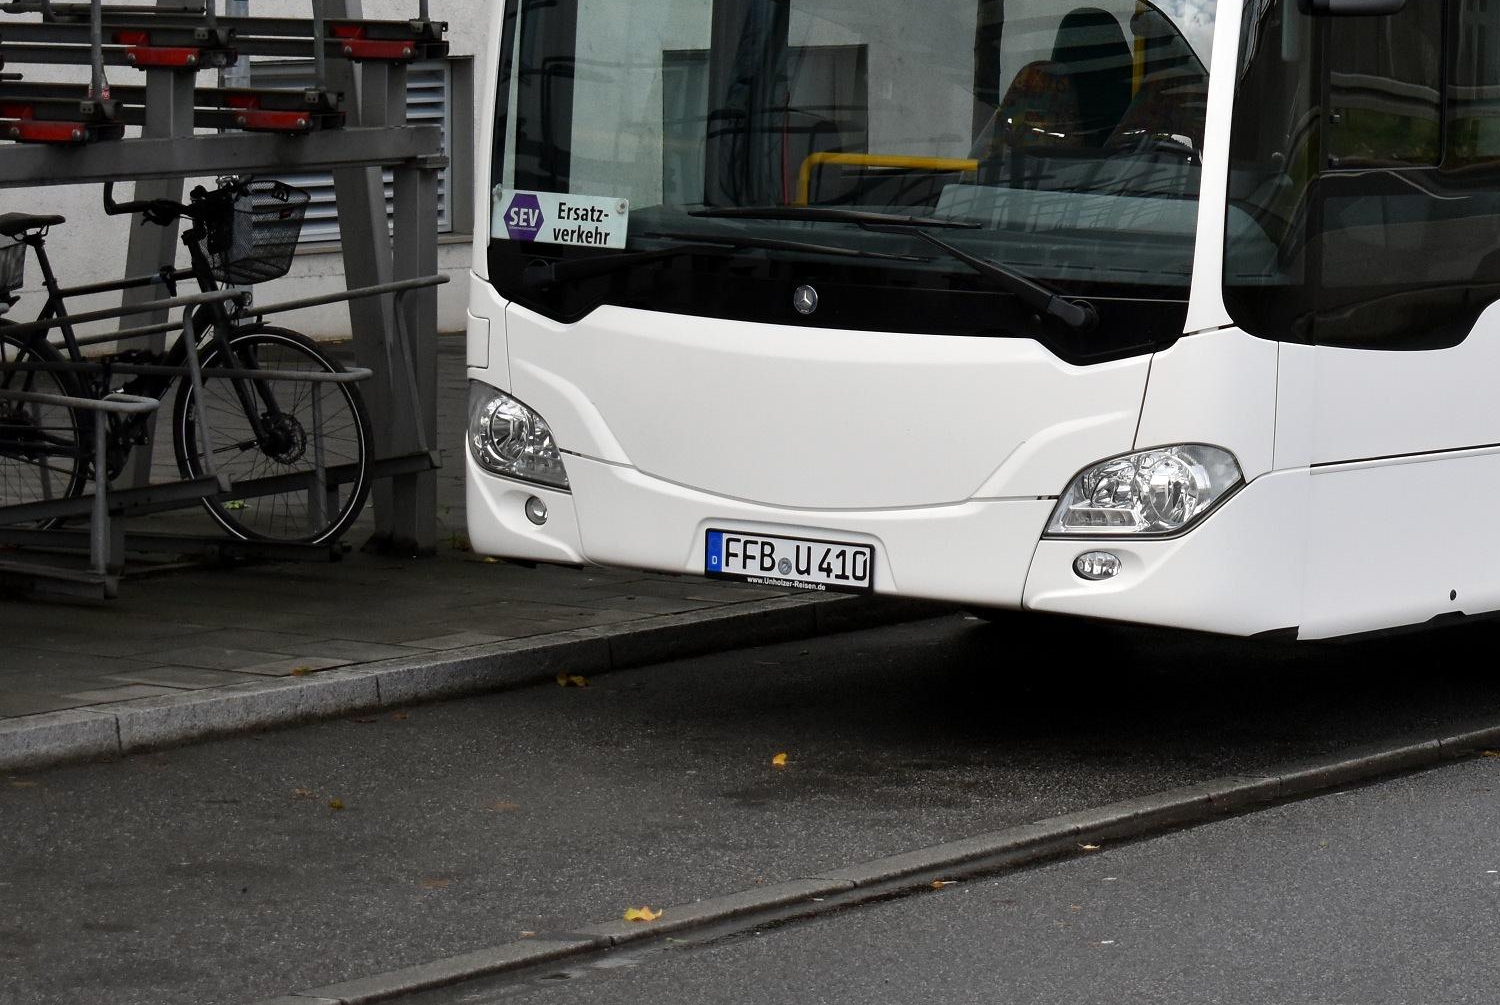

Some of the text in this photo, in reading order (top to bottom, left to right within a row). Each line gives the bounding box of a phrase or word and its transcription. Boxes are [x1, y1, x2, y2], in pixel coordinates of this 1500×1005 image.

[509, 207, 540, 227] SEV
[558, 202, 609, 223] Ersatz-
[553, 225, 611, 245] verkehr
[725, 537, 868, 581] FFB U 410
